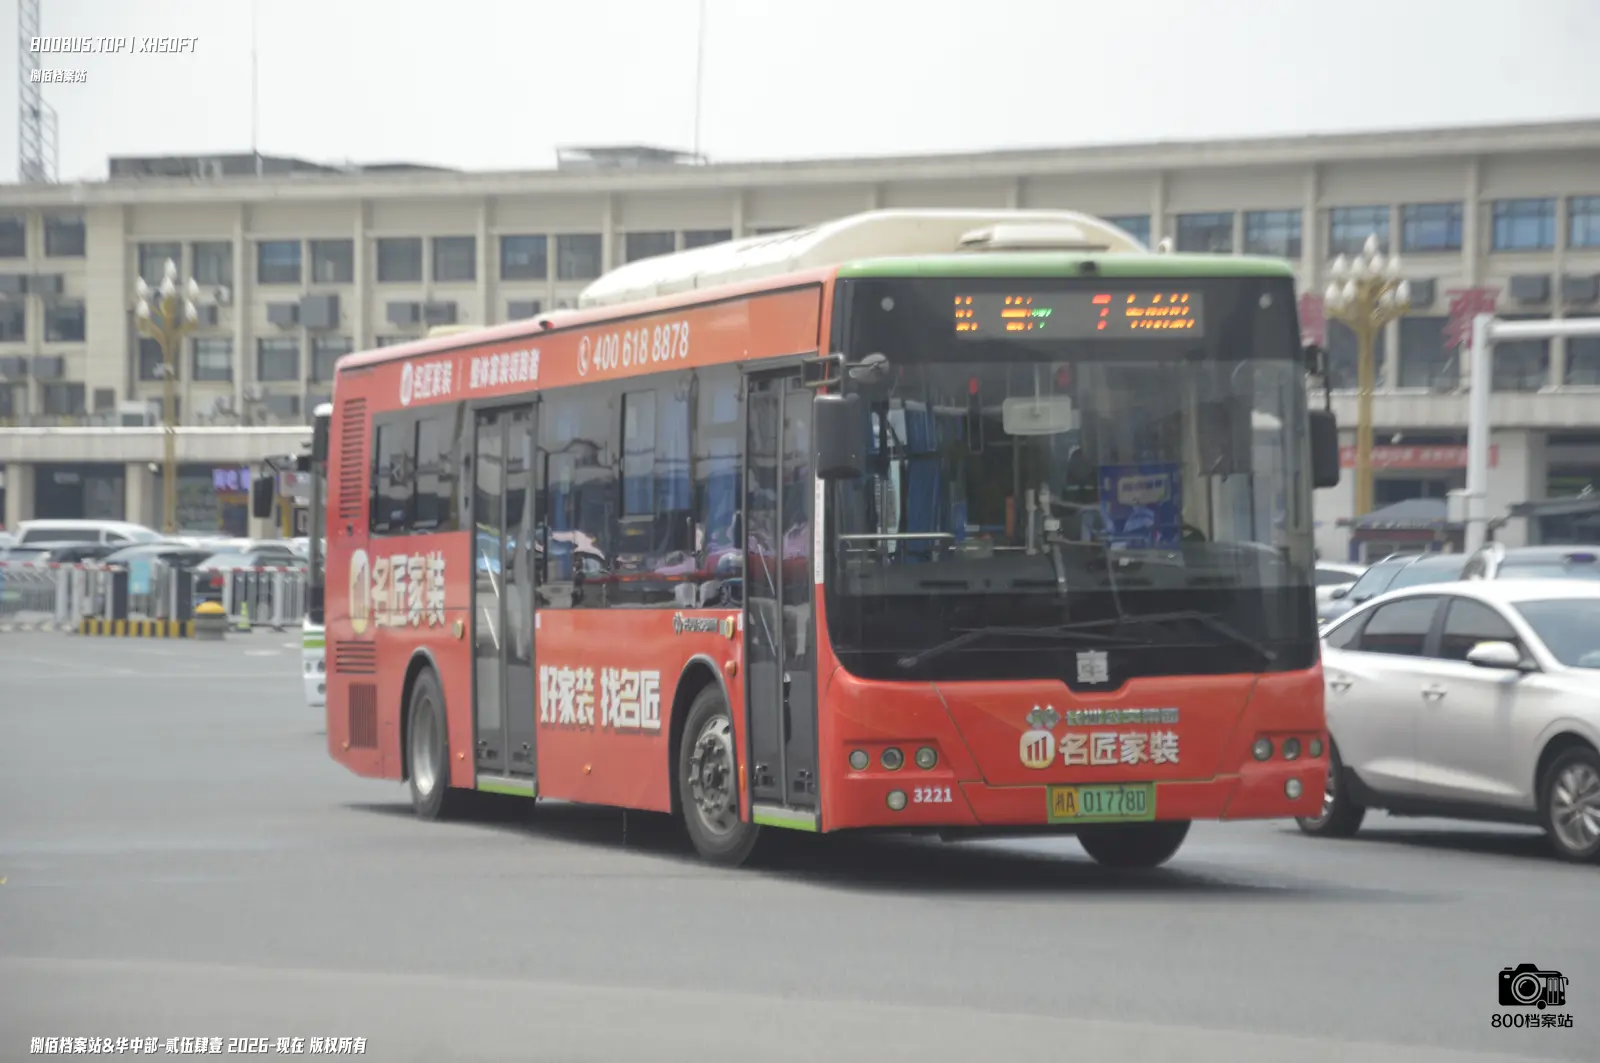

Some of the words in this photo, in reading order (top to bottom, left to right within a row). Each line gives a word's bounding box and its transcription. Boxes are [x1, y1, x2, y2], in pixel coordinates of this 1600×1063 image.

[593, 333, 619, 371] 400
[622, 328, 648, 367] 618
[652, 320, 690, 362] 8878
[539, 665, 595, 726] 好家装
[600, 666, 661, 730] 找名匠
[913, 785, 953, 803] 3221
[1083, 790, 1146, 813] 01778D
